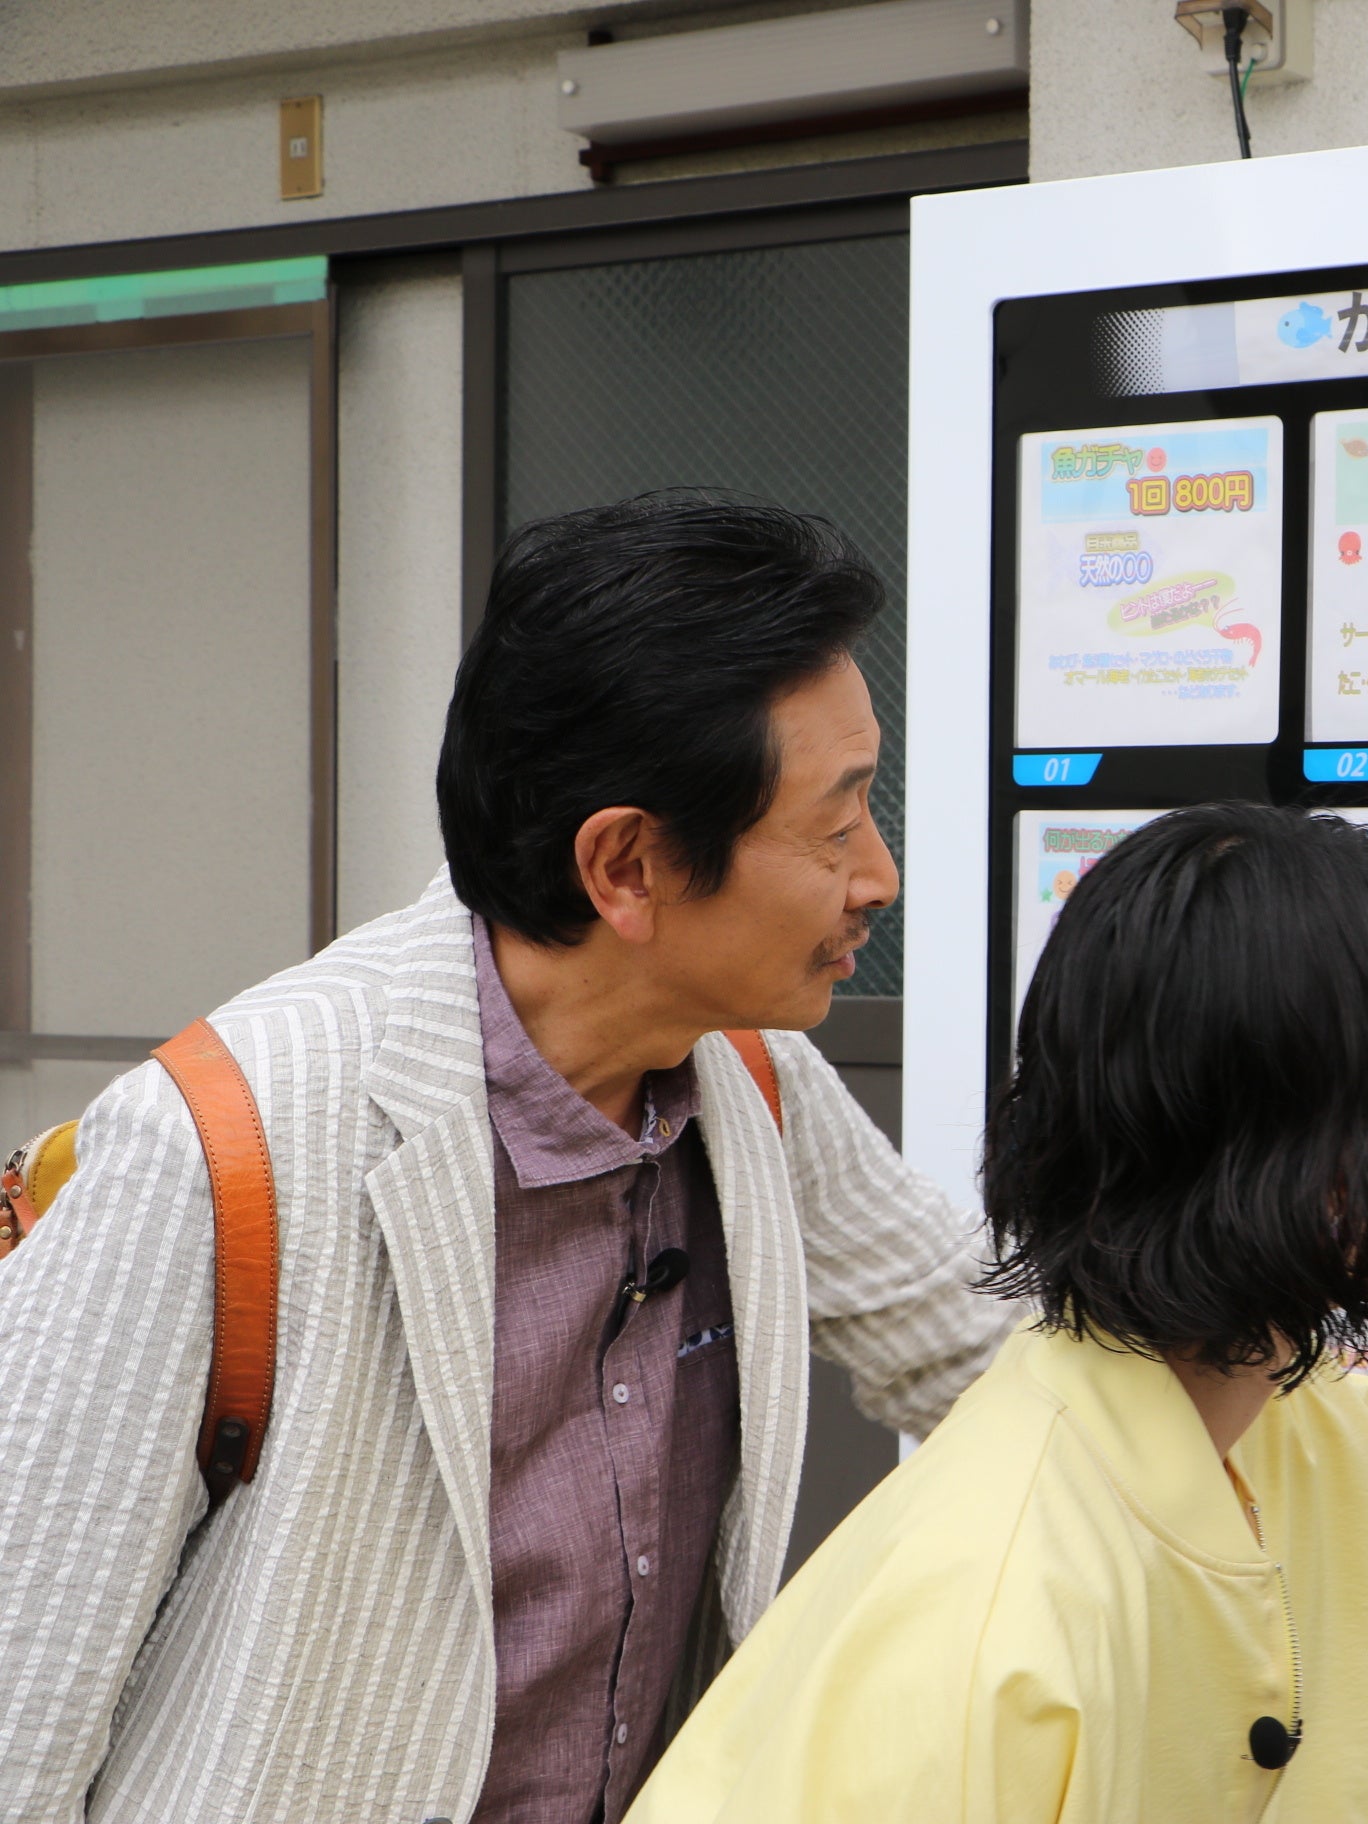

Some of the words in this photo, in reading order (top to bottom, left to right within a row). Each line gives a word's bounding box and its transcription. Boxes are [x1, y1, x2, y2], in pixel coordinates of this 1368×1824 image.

[1051, 444, 1144, 482] 魚ガチャ
[1043, 757, 1072, 782] 01
[1336, 751, 1368, 778] 02
